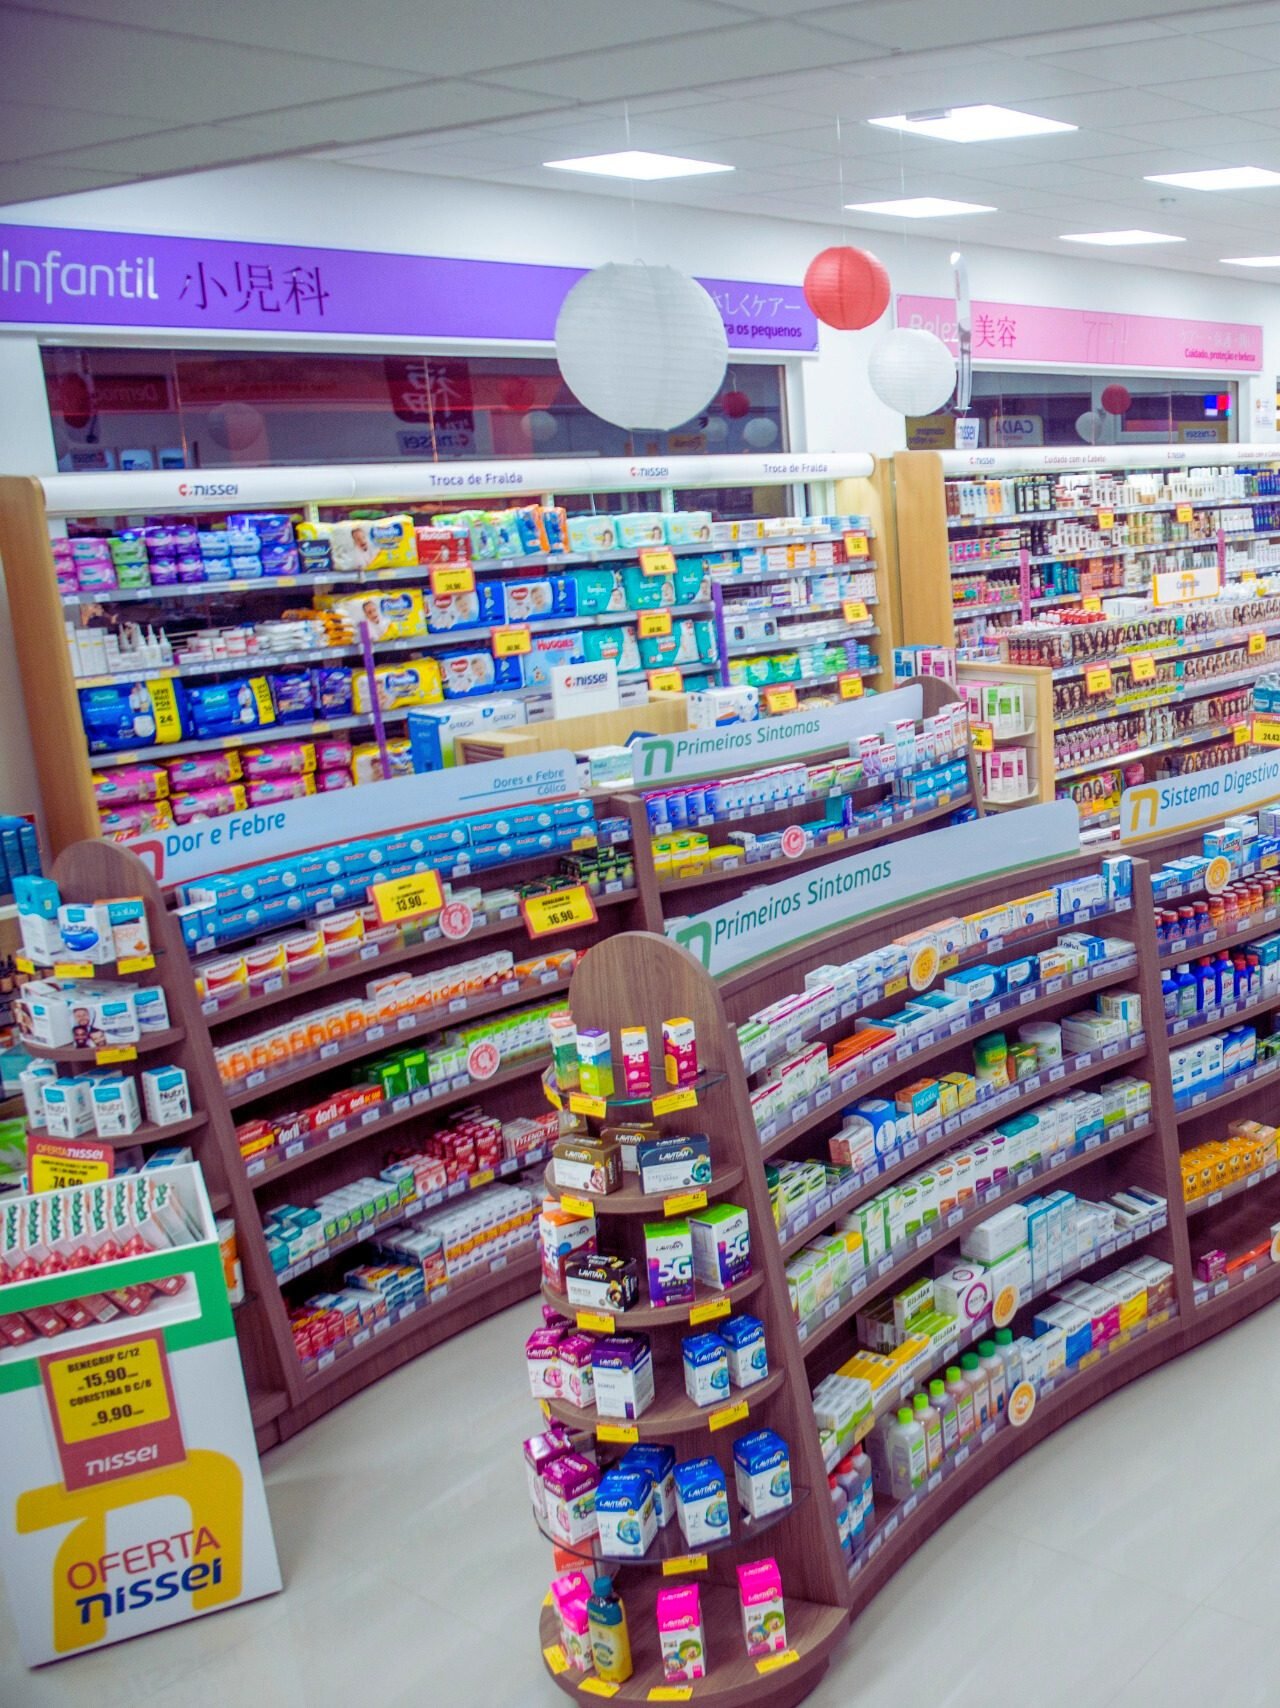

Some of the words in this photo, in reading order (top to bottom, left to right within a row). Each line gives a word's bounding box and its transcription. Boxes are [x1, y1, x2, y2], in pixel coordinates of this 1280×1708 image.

[1, 249, 159, 305] Infantil
[179, 260, 330, 317] 小児科
[751, 323, 803, 339] pequenos
[975, 314, 1018, 349] 美容
[763, 463, 787, 474] Troca
[788, 463, 800, 473] de
[801, 462, 828, 473] Fralda
[429, 474, 464, 488] Troca
[468, 473, 482, 486] de
[485, 471, 523, 485] Fralda
[193, 483, 239, 497] nissei
[537, 638, 574, 652] HUGGIES
[575, 672, 609, 687] nissei
[676, 730, 753, 759] Primeiros
[756, 719, 821, 746] Sintomas
[493, 773, 524, 789] Dores
[526, 774, 533, 784] e
[535, 766, 565, 782] Febre
[1160, 779, 1220, 810] Sistema
[1223, 761, 1280, 794] Digestivo
[165, 831, 204, 858] Dor
[209, 827, 222, 845] e
[229, 812, 286, 842] Febre
[396, 894, 422, 911] 13,90
[713, 888, 803, 946] Primeiros
[806, 858, 893, 903] Sintomas
[547, 908, 574, 926] 16,90
[678, 1043, 693, 1054] 5G
[628, 1053, 645, 1065] 5G
[159, 1086, 186, 1100] Nutri
[315, 1104, 338, 1124] doril
[278, 1125, 301, 1145] doril
[515, 1129, 546, 1147] TYLENOL
[67, 1147, 104, 1160] nissei
[658, 1149, 690, 1161] LAVITAN
[725, 1231, 750, 1266] 5G
[577, 1268, 605, 1280] LAVITAN
[658, 1255, 693, 1282] 5G
[906, 1287, 931, 1308] Bisalax
[932, 1322, 957, 1346] Bisalax
[66, 1353, 116, 1375] BENEGRIP
[116, 1347, 140, 1362] C/12
[82, 1365, 128, 1391] 15,90
[68, 1384, 123, 1407] CORISTINA
[122, 1383, 132, 1394] D
[96, 1403, 134, 1426] 9,90
[85, 1443, 159, 1477] nissei
[754, 1453, 782, 1470] LAVITAN
[687, 1482, 718, 1499] LAVITAN
[599, 1498, 629, 1508] LAVITAN
[66, 1525, 222, 1592] OFERTA
[75, 1557, 223, 1626] nissei
